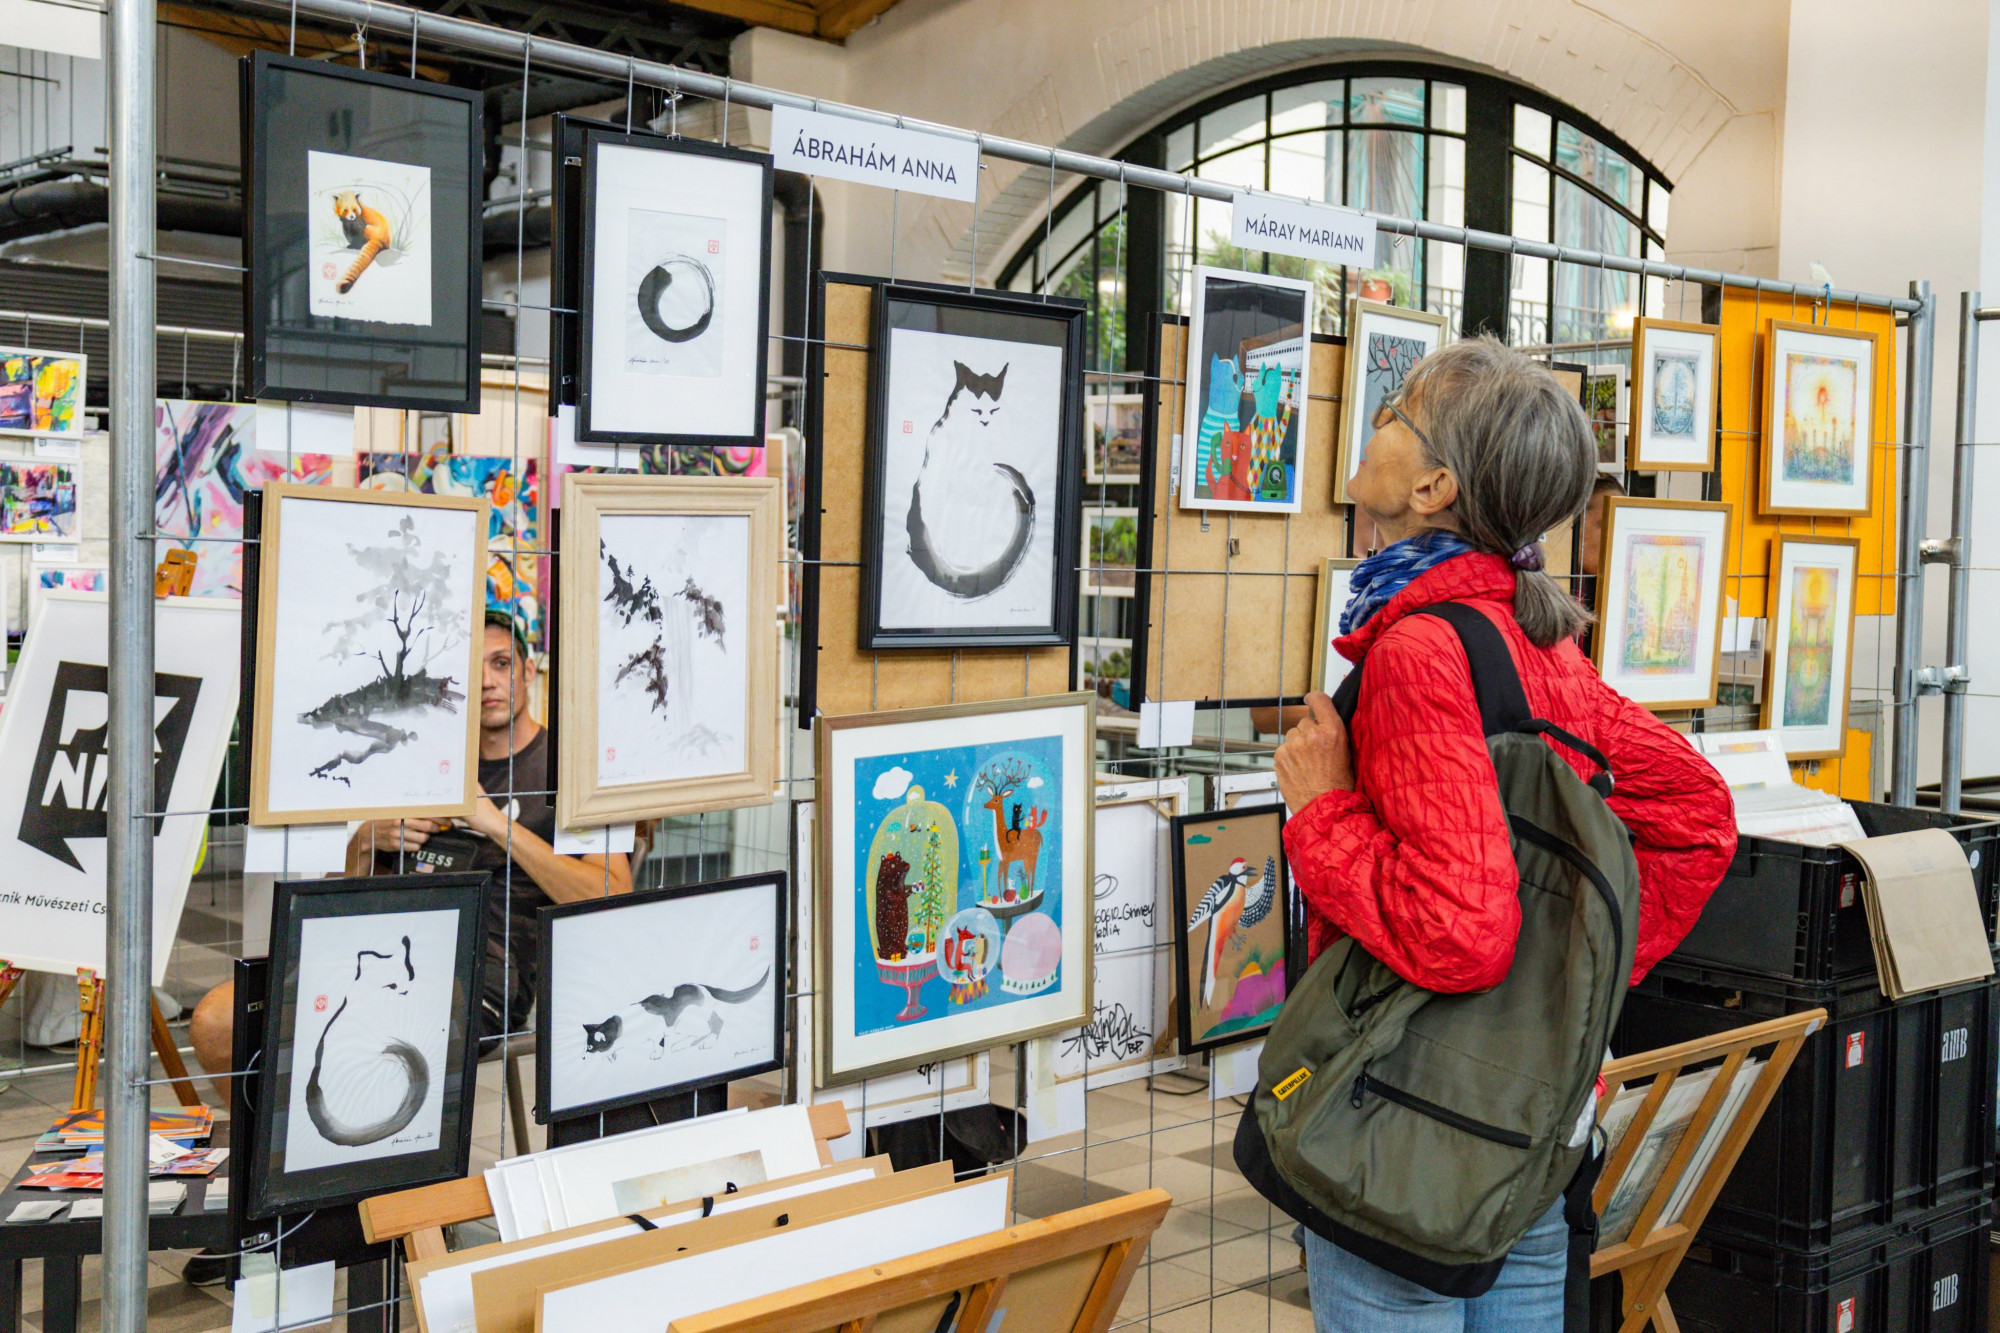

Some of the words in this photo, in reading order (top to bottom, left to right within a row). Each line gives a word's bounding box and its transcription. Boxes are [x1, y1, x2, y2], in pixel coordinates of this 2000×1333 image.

[792, 129, 896, 173] ÁBRAHÁM
[901, 156, 957, 184] ANNA
[1245, 213, 1296, 241] MÁRAY
[1299, 226, 1364, 253] MARIANN
[58, 688, 181, 753] PK
[41, 750, 161, 813] NI
[411, 850, 454, 867] UESS
[25, 894, 90, 912] Művészeti
[92, 902, 107, 914] Cs
[1277, 1070, 1308, 1096] CATERPILLAR
